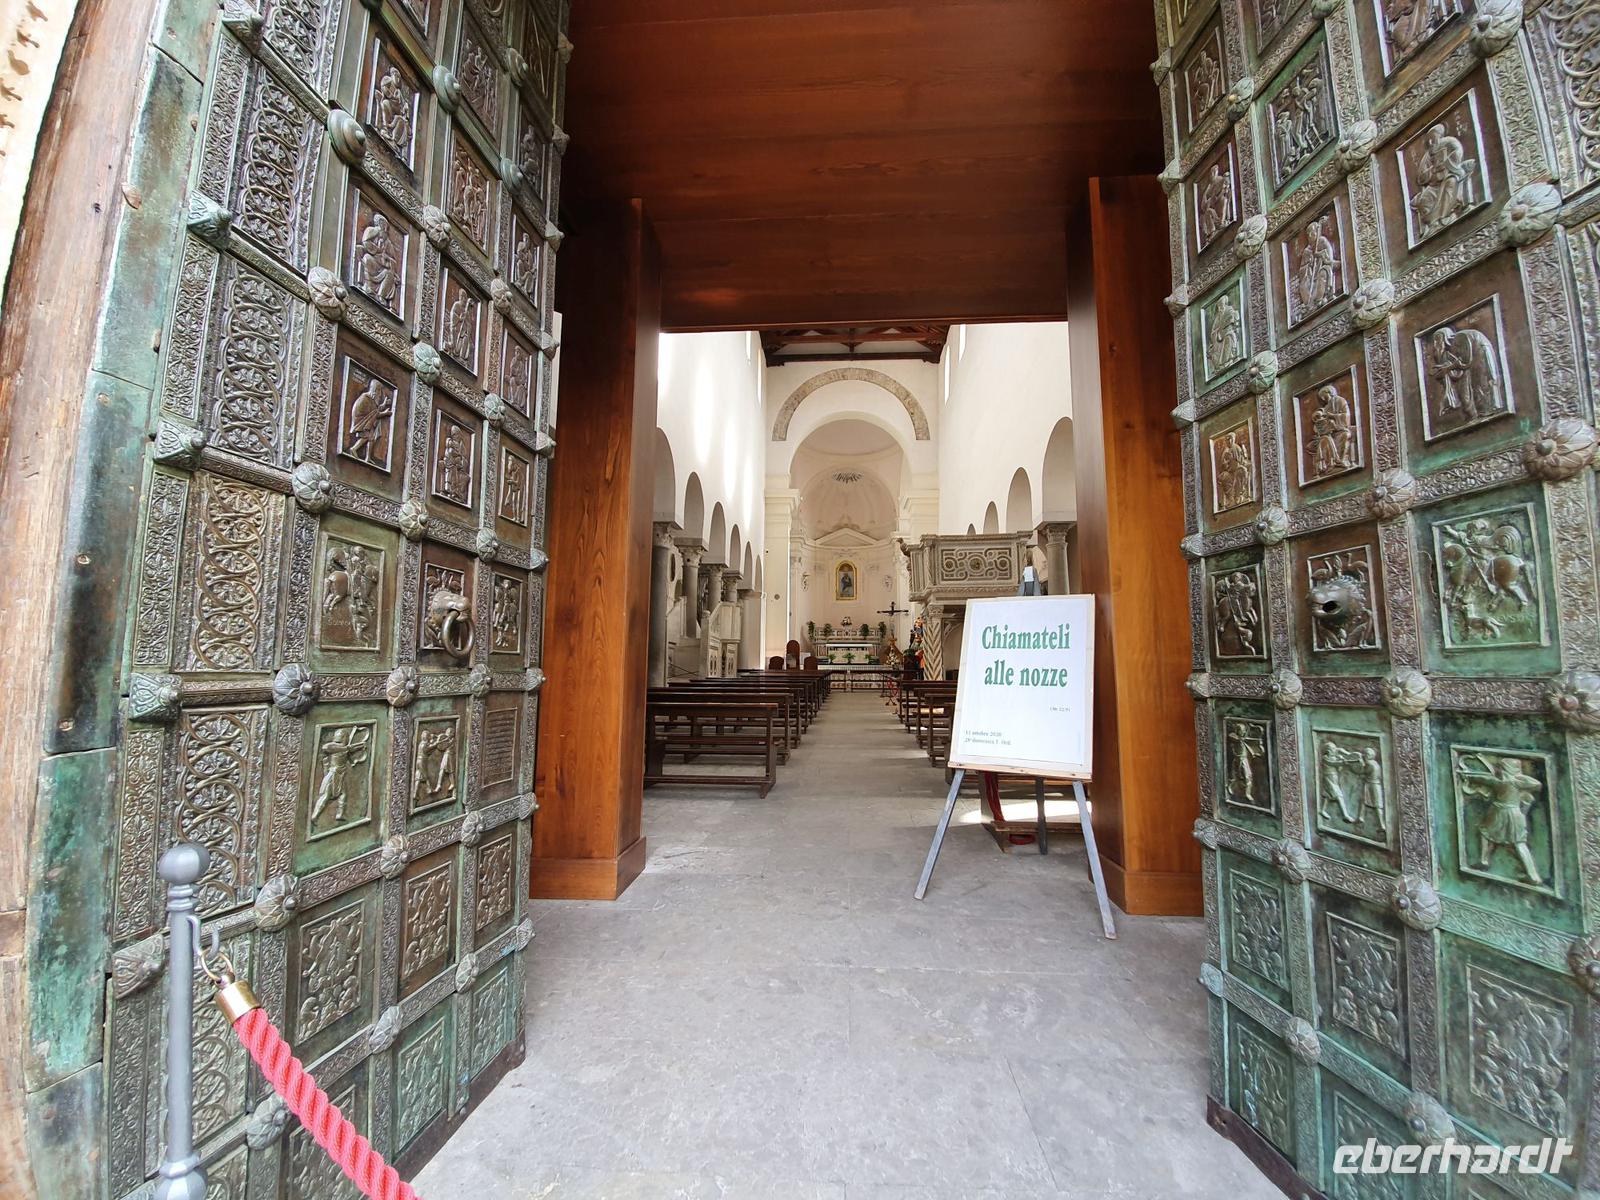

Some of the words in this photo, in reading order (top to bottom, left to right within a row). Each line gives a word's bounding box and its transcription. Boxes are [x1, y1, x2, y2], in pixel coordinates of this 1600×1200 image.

[981, 623, 1070, 649] Chiamateli
[984, 659, 1014, 686] alle
[1019, 667, 1068, 687] nozze
